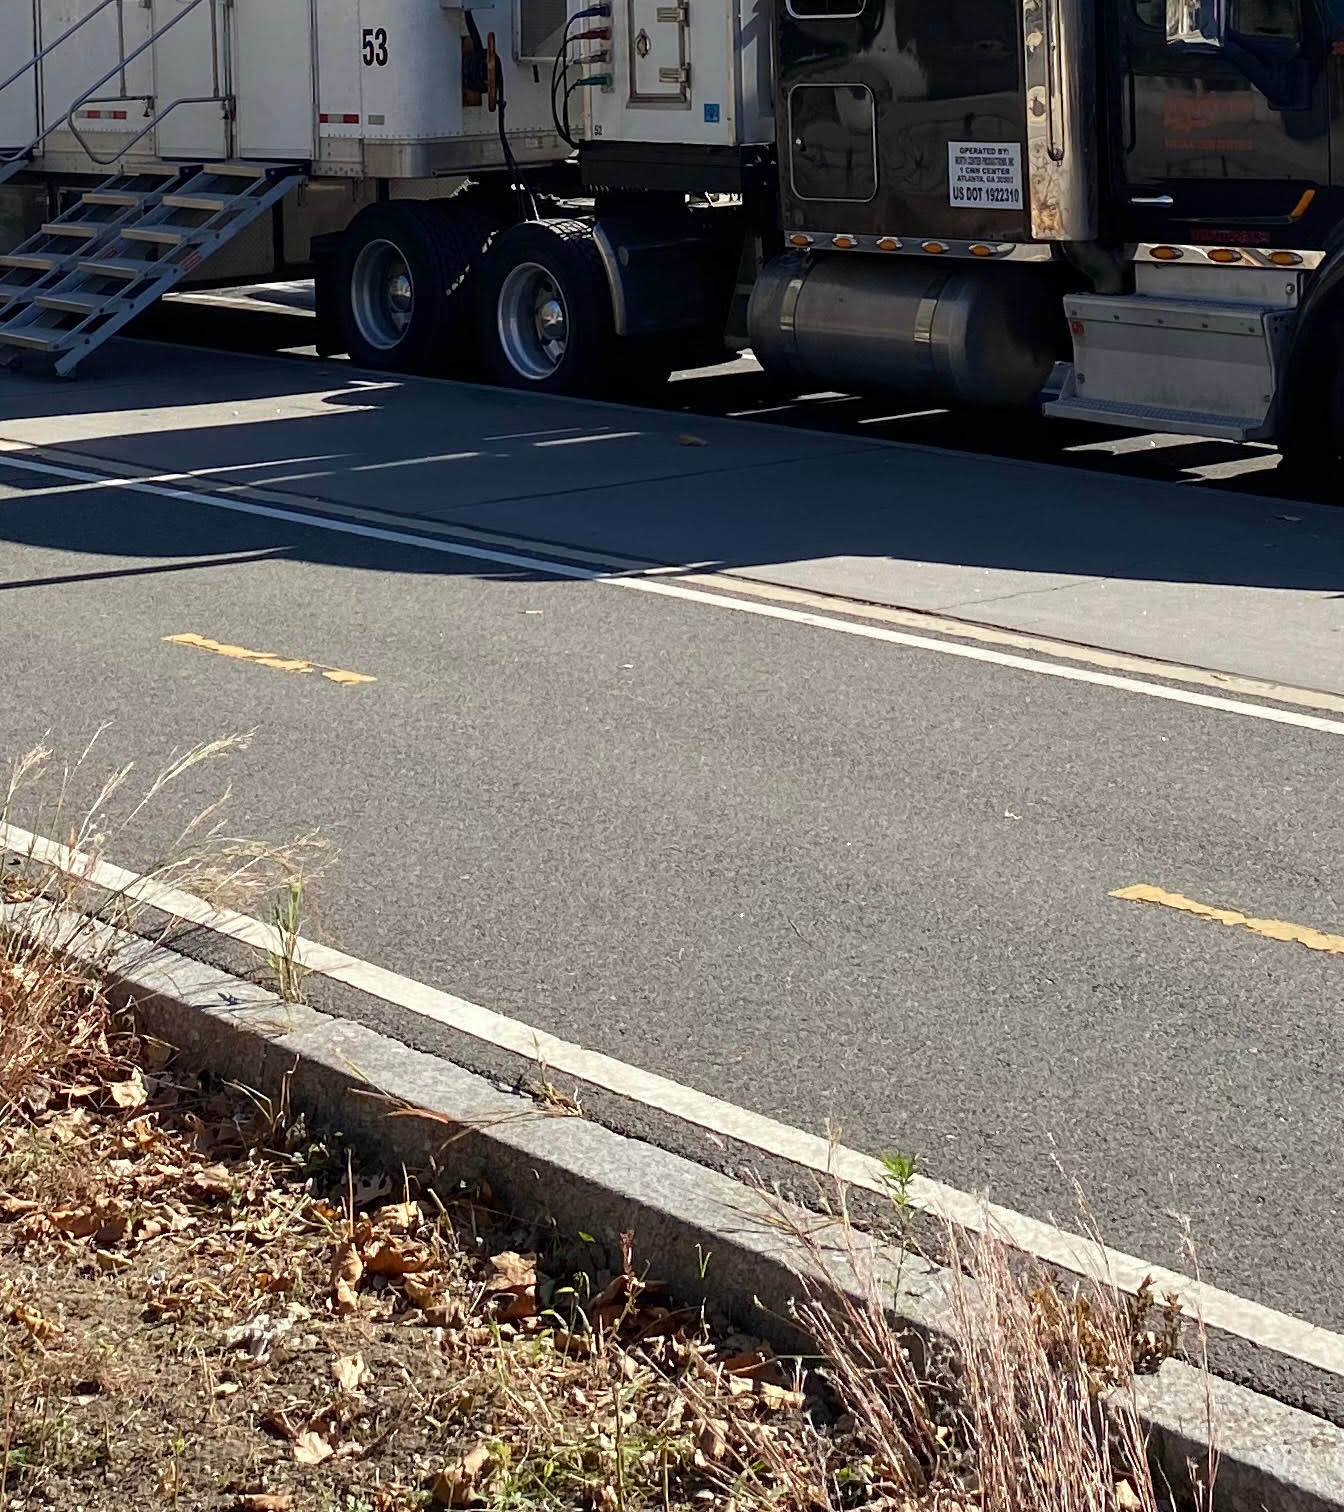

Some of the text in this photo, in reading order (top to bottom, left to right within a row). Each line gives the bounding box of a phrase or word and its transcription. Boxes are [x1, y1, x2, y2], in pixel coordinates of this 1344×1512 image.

[362, 27, 389, 67] 53
[959, 147, 1010, 156] OPERATED BY:
[953, 186, 1020, 203] US DOT 1922310
